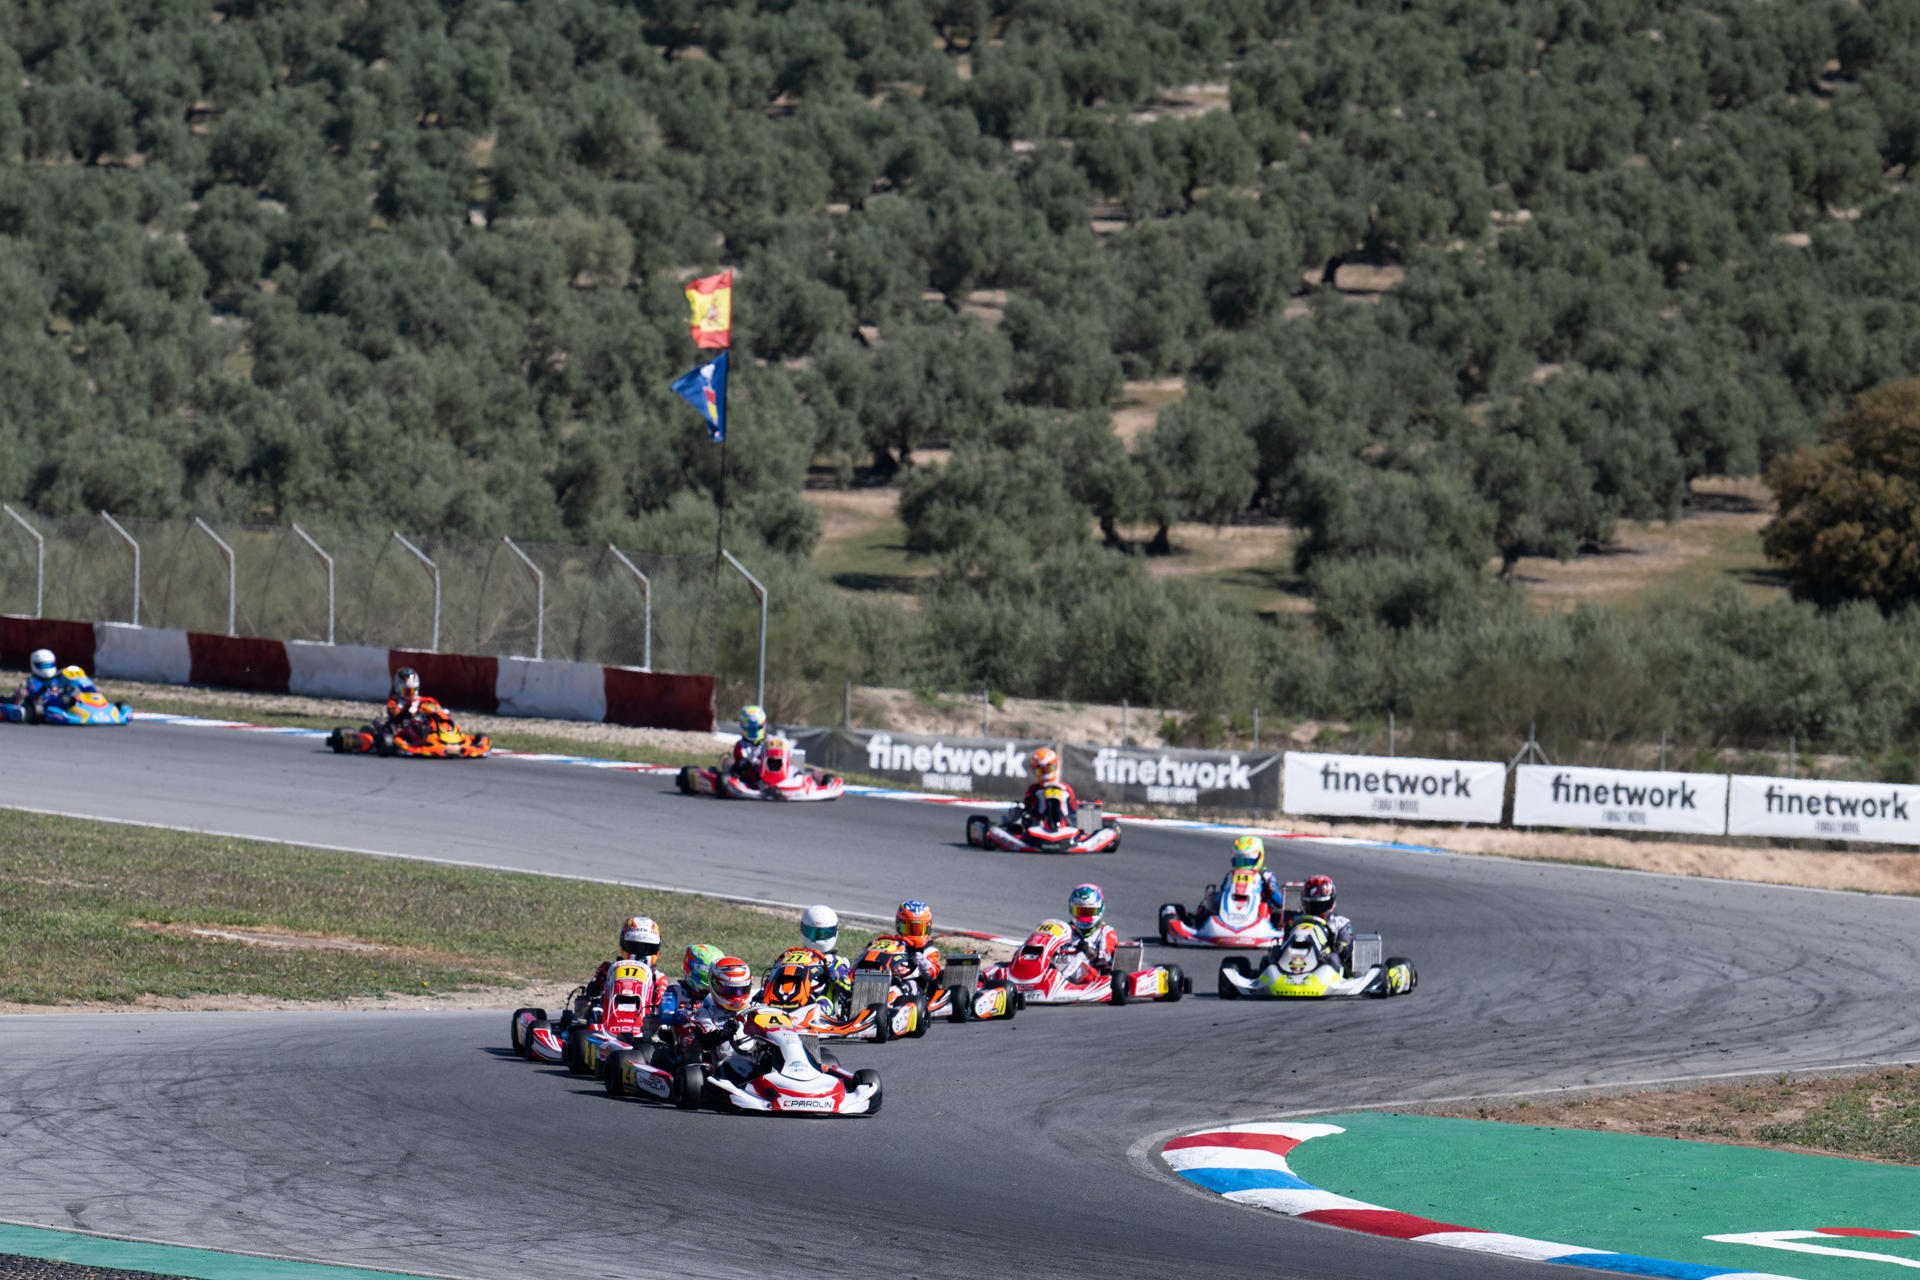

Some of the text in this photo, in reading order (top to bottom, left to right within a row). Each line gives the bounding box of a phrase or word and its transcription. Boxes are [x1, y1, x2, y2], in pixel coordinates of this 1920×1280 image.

[866, 734, 1027, 778] finetwork
[1093, 748, 1251, 789] finetwork
[1320, 762, 1471, 798] finetwork
[1552, 773, 1696, 809] finetwork
[1765, 785, 1909, 821] finetwork
[623, 967, 639, 977] 17
[785, 954, 804, 963] 27
